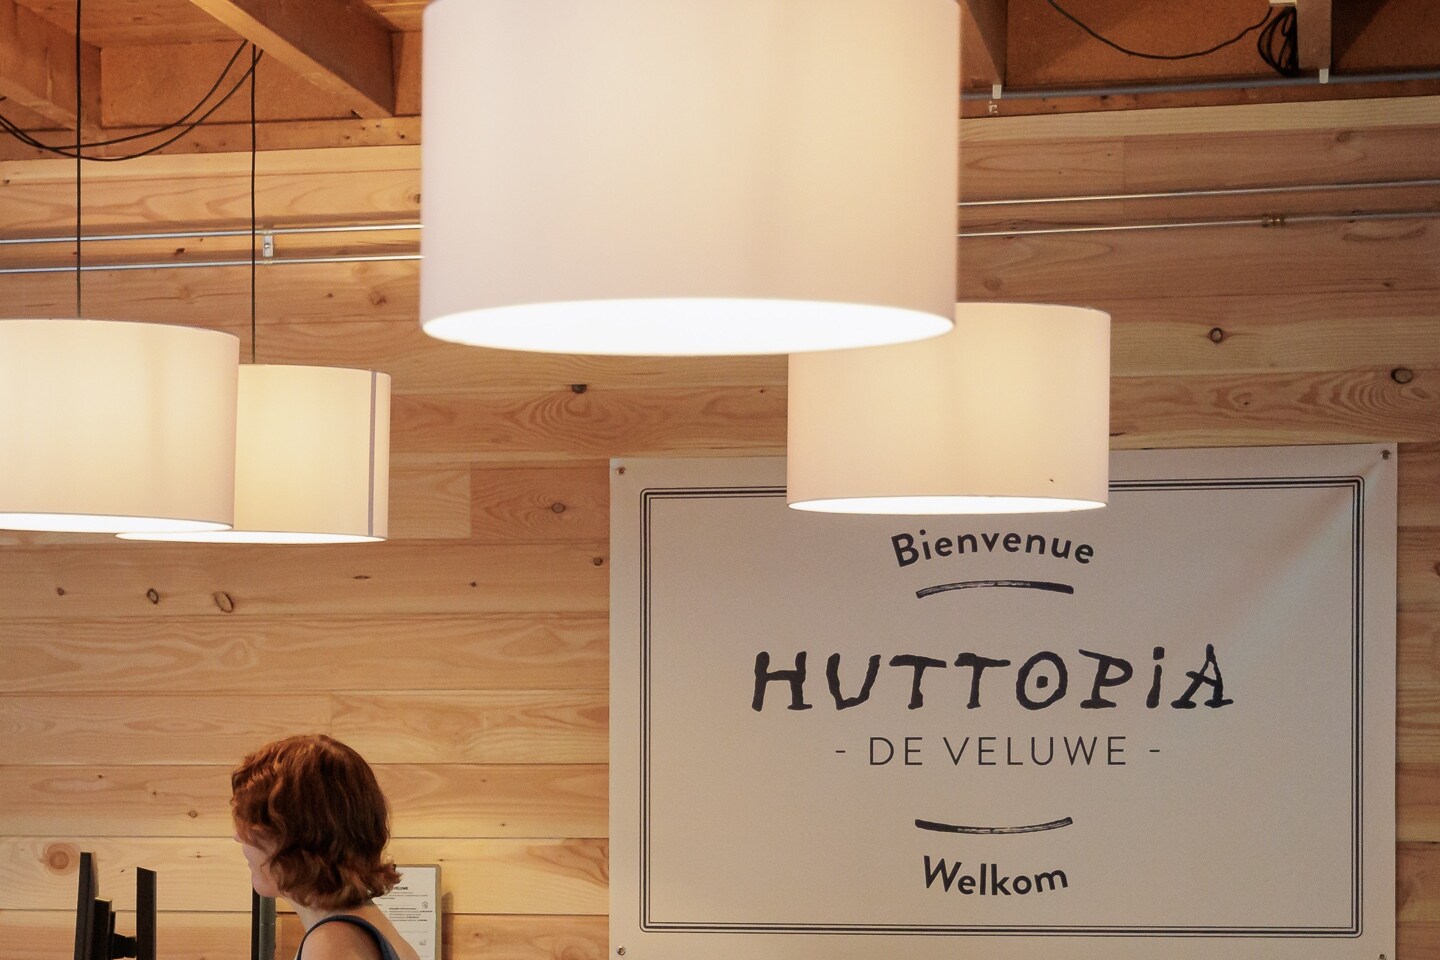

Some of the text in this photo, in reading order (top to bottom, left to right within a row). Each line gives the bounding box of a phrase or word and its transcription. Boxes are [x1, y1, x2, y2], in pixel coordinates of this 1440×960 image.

[890, 529, 1094, 568] Bienvenue
[869, 736, 923, 766] DE
[942, 735, 1127, 766] VELUWE
[923, 855, 1069, 896] Welkom
